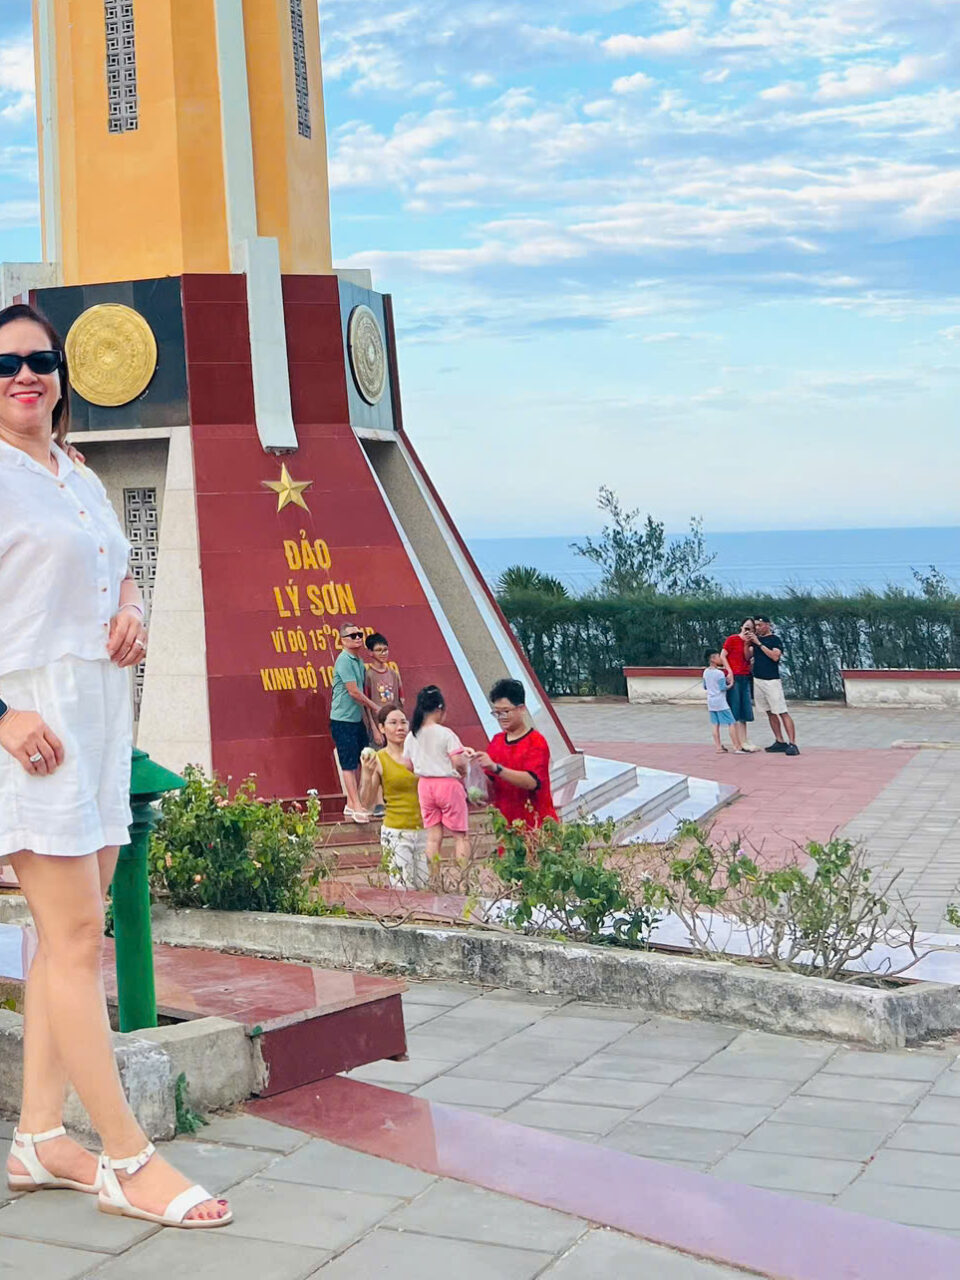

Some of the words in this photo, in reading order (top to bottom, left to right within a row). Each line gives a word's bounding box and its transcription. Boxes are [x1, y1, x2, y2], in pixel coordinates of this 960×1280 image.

[283, 529, 332, 570] ĐẢO
[274, 579, 300, 617] LÝ
[306, 580, 357, 616] SƠN
[271, 626, 287, 654] VĨ
[287, 625, 308, 657] ĐỘ
[260, 667, 296, 691] KINH
[297, 661, 318, 693] ĐỘ
